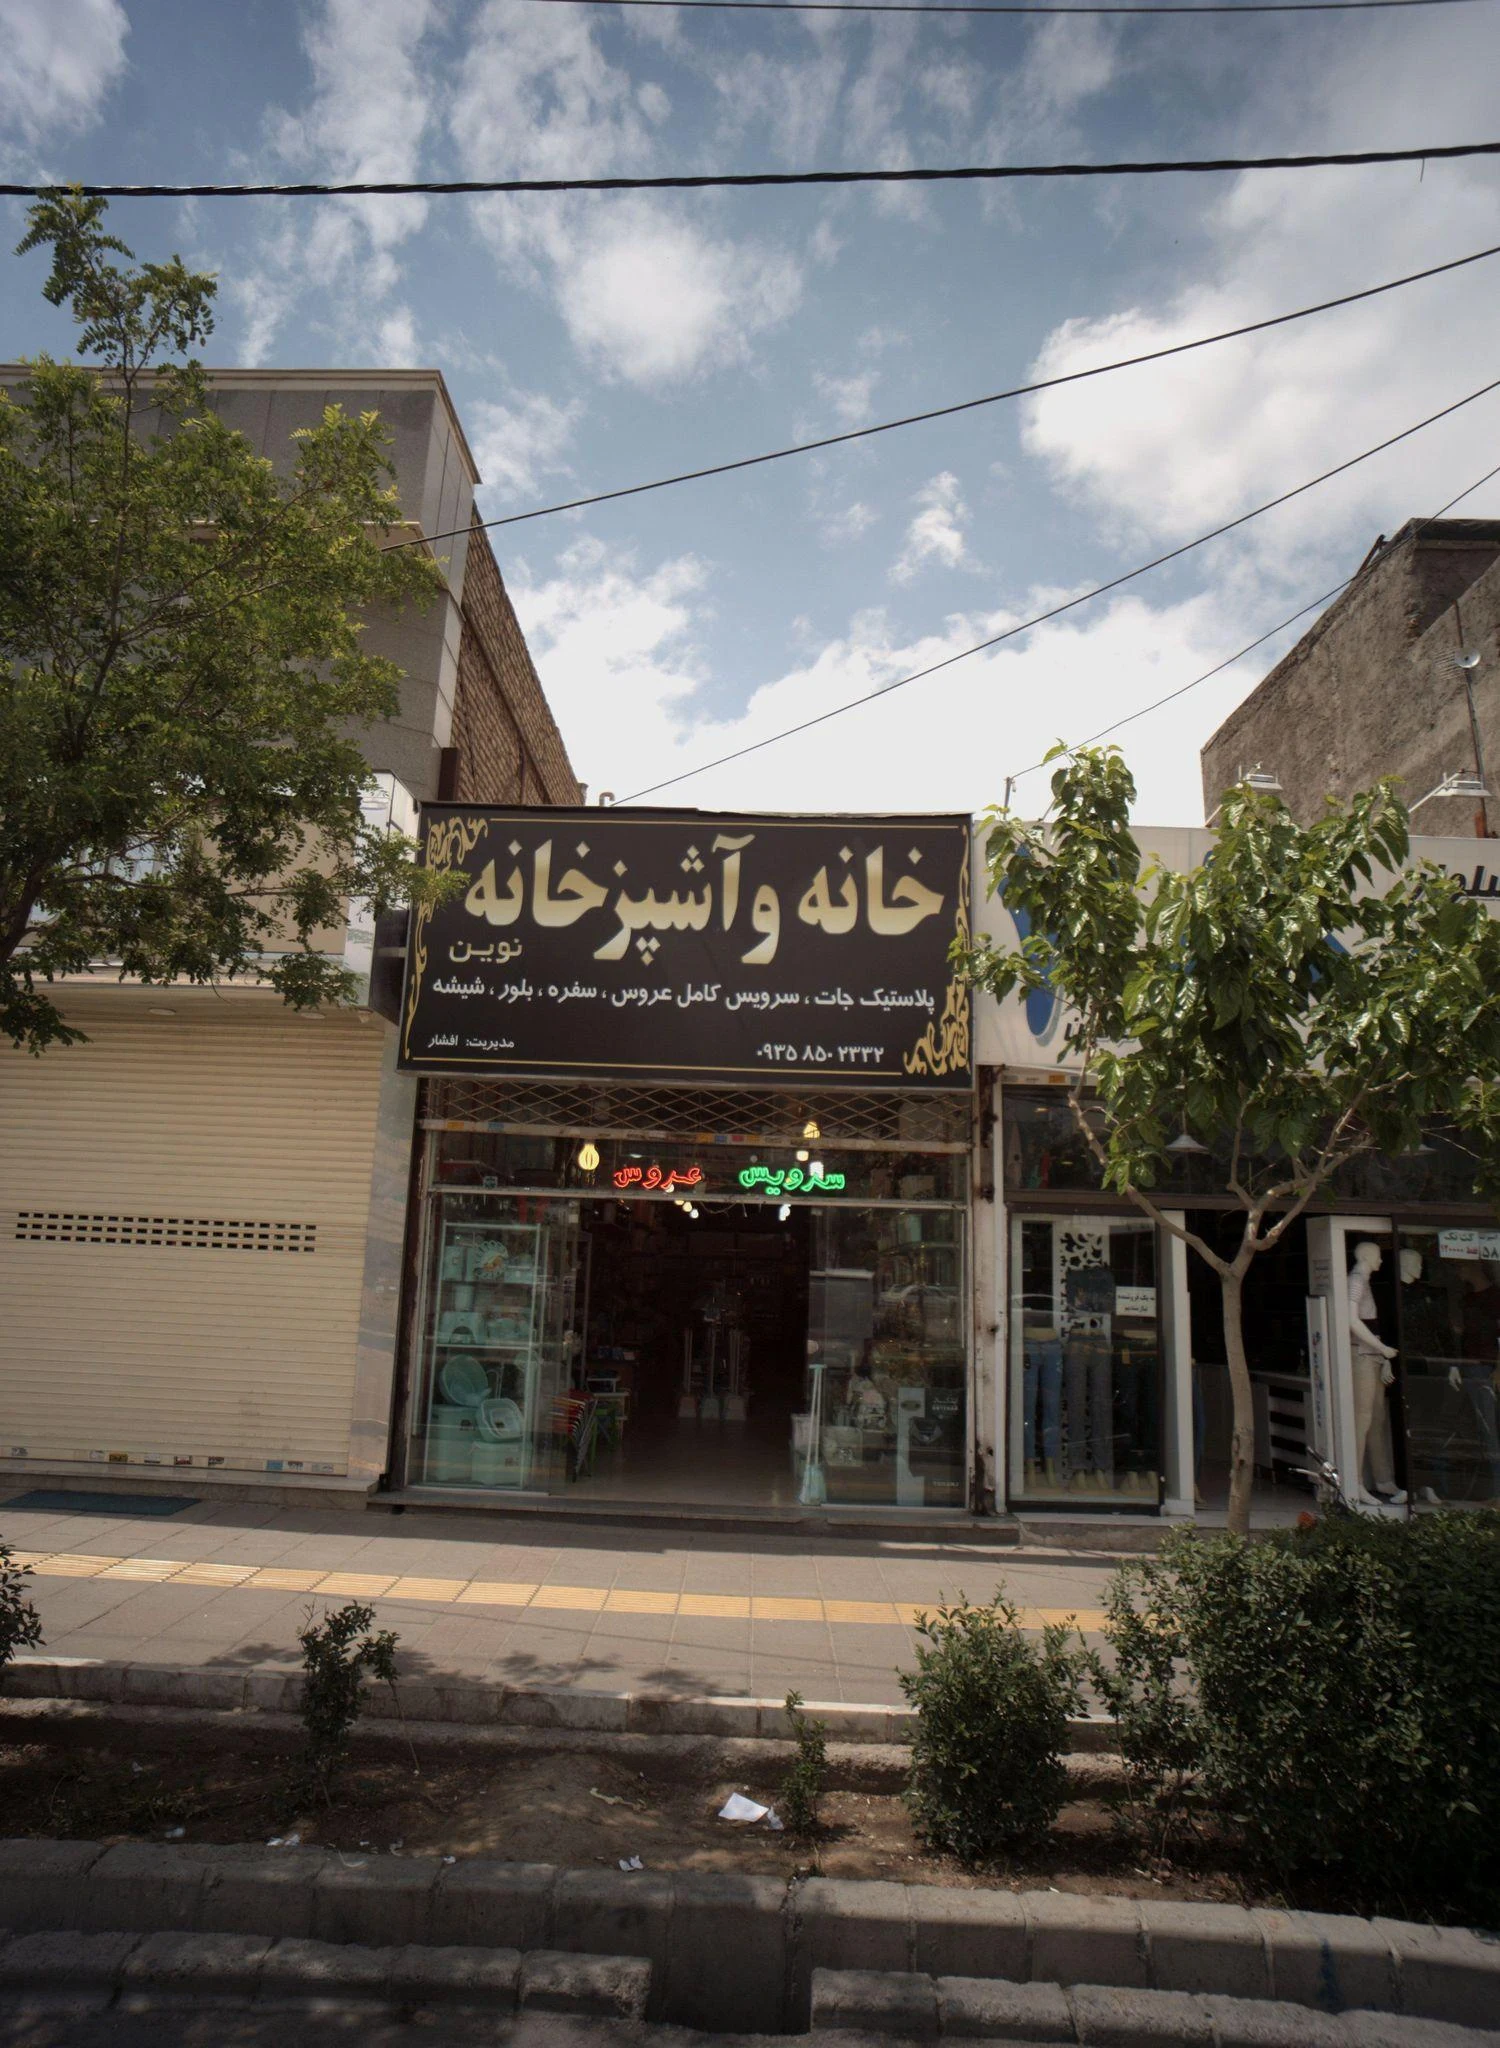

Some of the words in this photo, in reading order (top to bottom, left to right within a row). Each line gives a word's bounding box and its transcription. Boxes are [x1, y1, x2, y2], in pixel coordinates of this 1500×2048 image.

[464, 833, 756, 966] آشپزخانه
[797, 845, 945, 936] خانه
[740, 884, 780, 965] و
[449, 938, 523, 964] نوین
[432, 975, 486, 1000] شیشه
[676, 983, 722, 1009] کامل
[725, 988, 800, 1011] سرویس
[859, 987, 935, 1015] پلاستیک
[427, 1034, 459, 1048] افشار
[757, 1043, 798, 1062] ۰۹۳۵
[802, 1045, 833, 1062] ۸۵۰
[837, 1046, 885, 1063] ۲۳۳۲
[613, 1166, 702, 1190] عروس
[739, 1166, 846, 1196] سرویس
